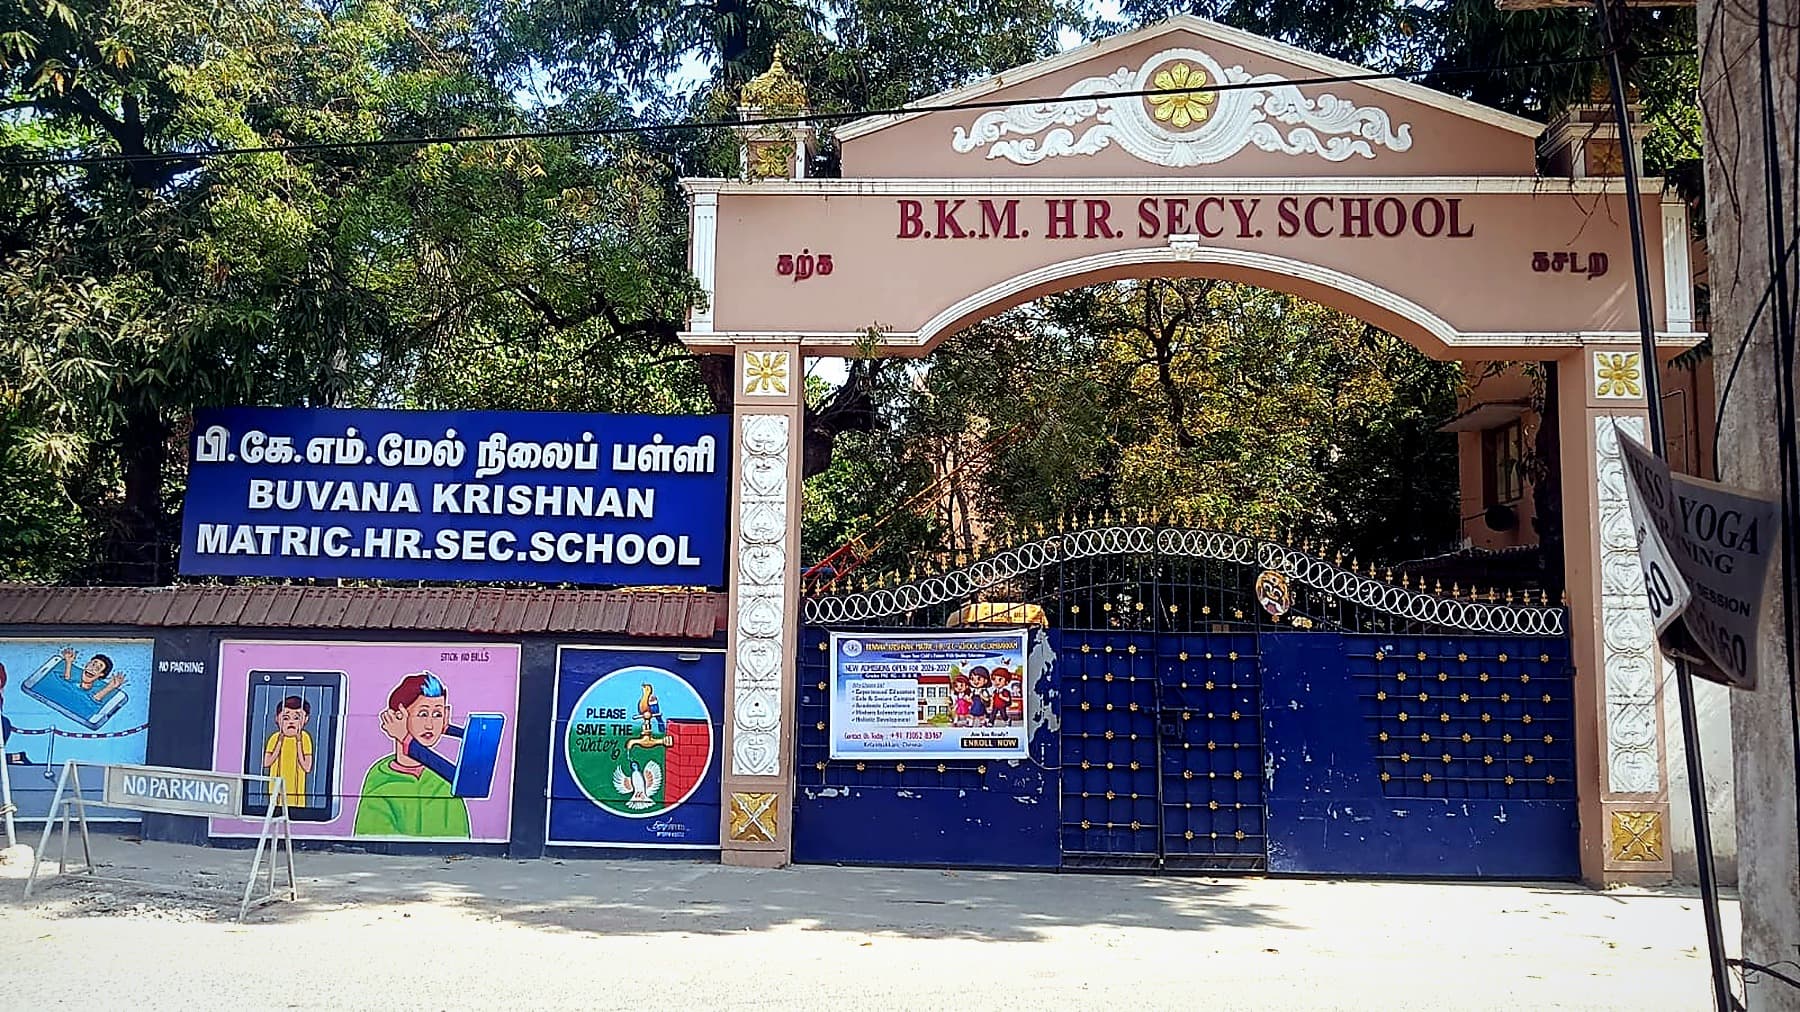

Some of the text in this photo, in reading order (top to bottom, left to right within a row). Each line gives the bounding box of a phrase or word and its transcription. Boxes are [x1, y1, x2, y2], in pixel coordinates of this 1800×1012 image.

[896, 197, 1474, 239] B.K.M. HR. SECY. SCHOOL
[777, 248, 833, 282] கற்க
[1532, 252, 1608, 281] கசடற
[475, 431, 599, 479] நிலைப்
[612, 433, 716, 473] பள்ளி
[249, 479, 655, 518] BUVANA KRISHNAN
[1678, 496, 1761, 555] YOGA
[196, 523, 701, 566] MATRIC.HR.SEC.SCHOOL
[159, 661, 204, 674] NO PARKING
[471, 651, 489, 662] BILLS
[586, 707, 626, 719] PLEASE
[576, 723, 633, 736] SAVE THE
[963, 739, 1017, 747] ENROLL NOW
[123, 775, 229, 805] NO PARKING
